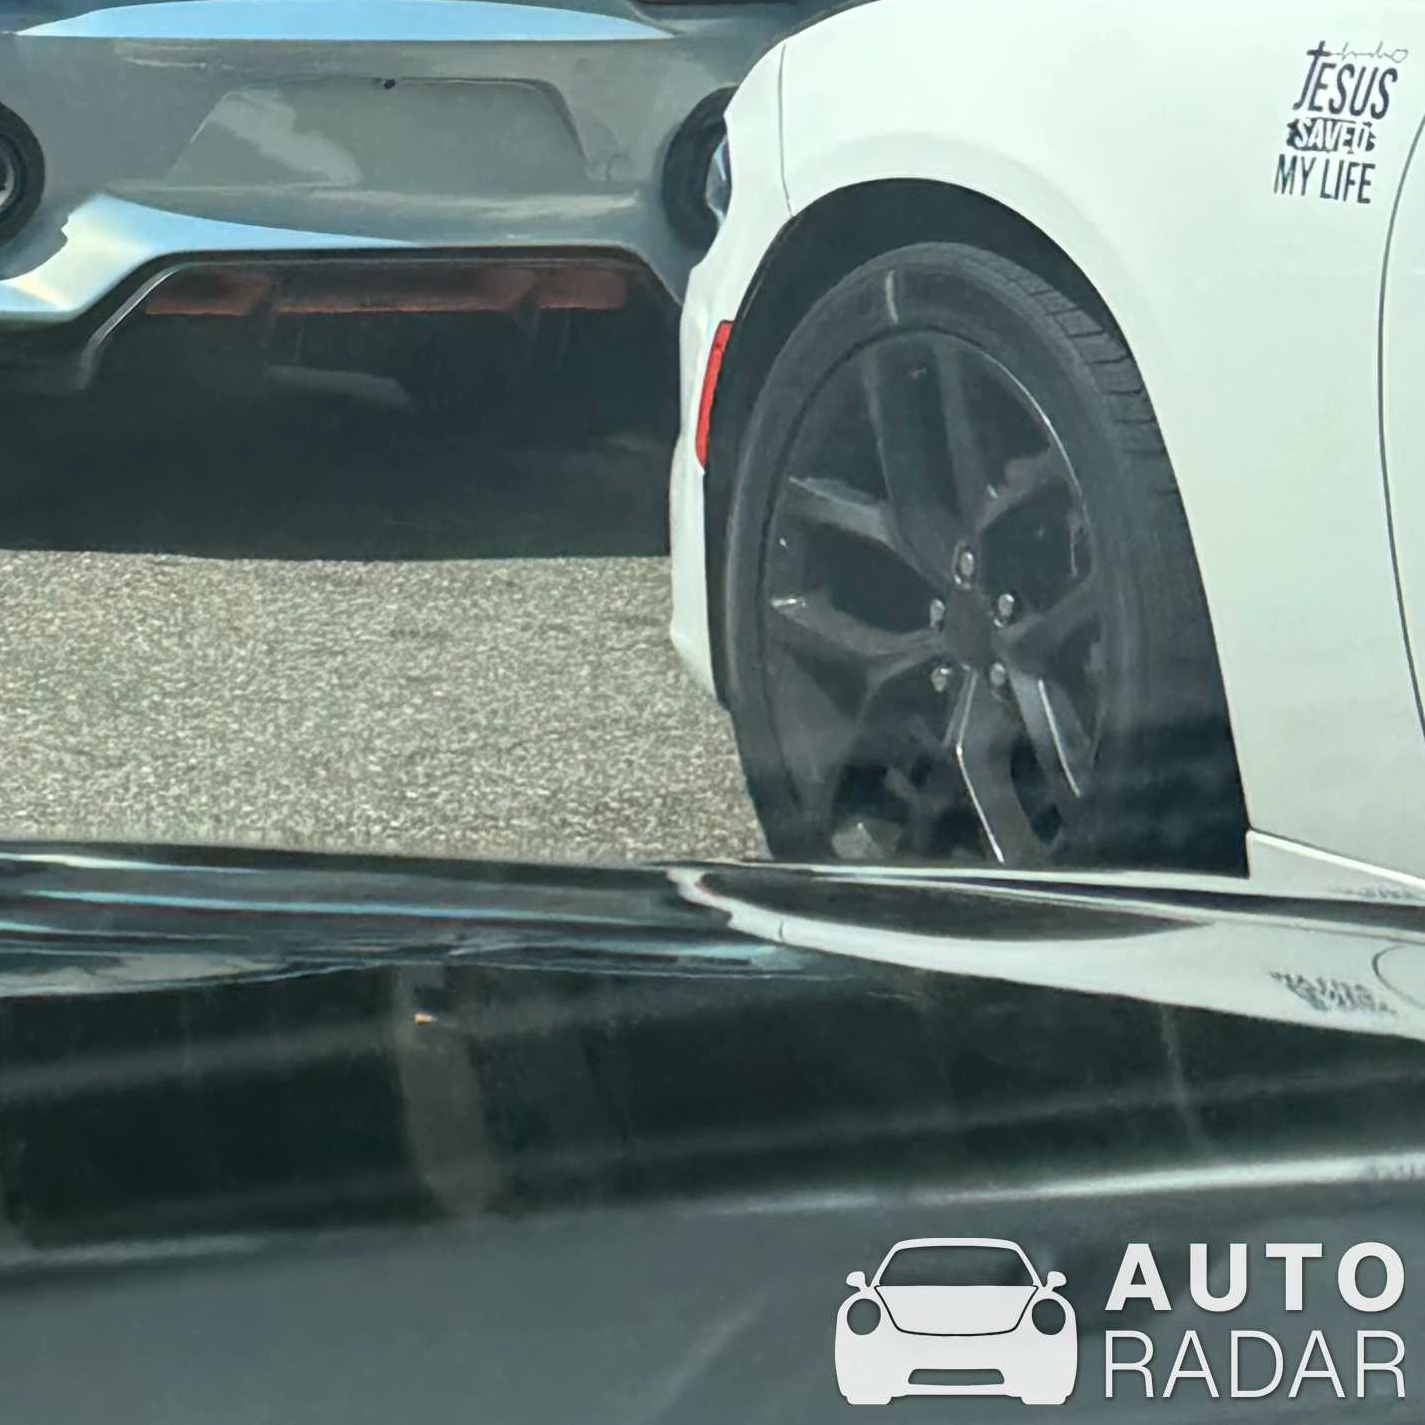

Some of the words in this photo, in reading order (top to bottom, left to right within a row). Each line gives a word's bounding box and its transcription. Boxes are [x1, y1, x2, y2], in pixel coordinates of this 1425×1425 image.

[1292, 41, 1398, 120] JESUS
[1274, 153, 1317, 196] MY
[1320, 158, 1376, 204] LIFE
